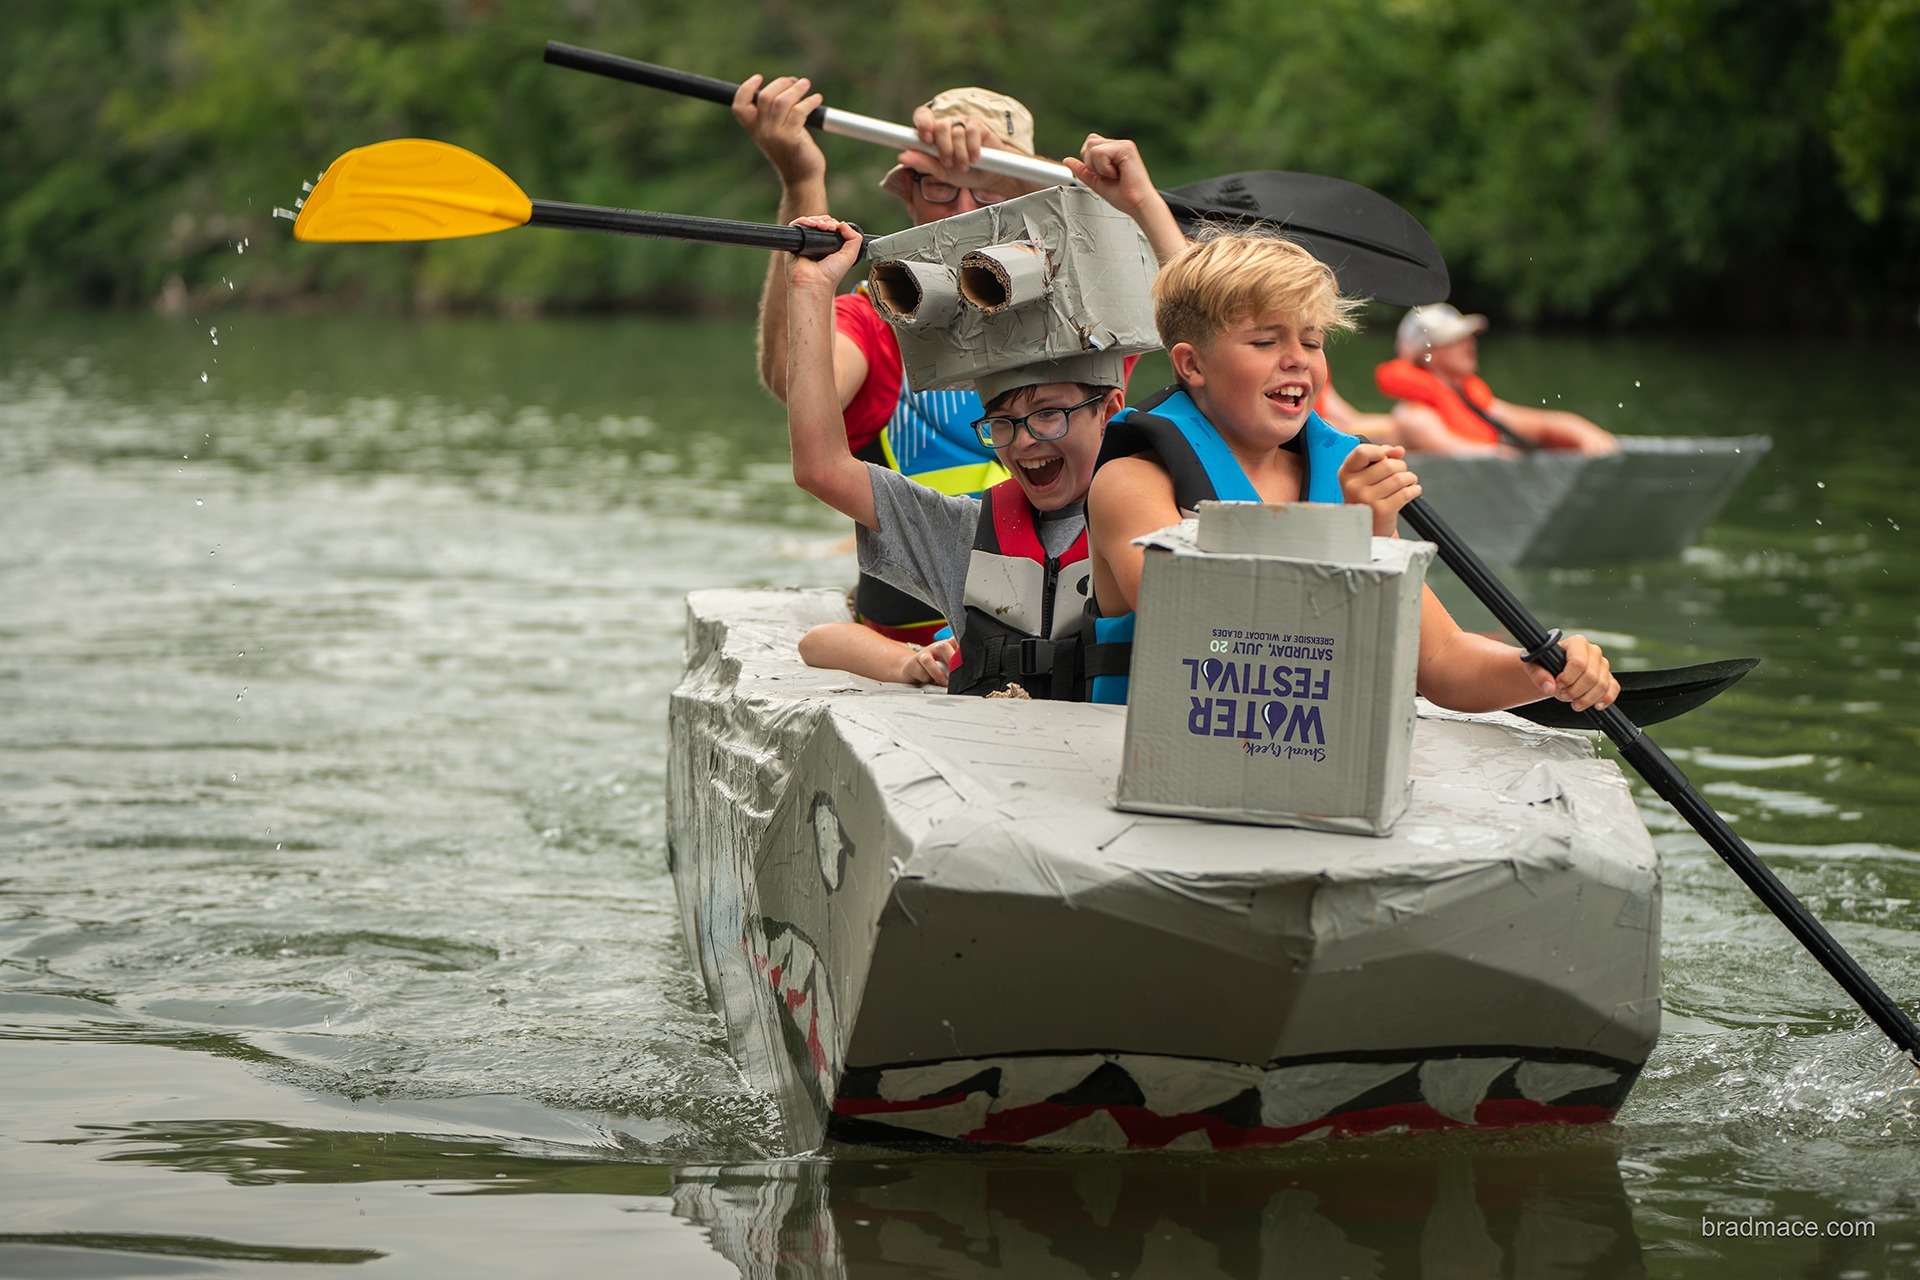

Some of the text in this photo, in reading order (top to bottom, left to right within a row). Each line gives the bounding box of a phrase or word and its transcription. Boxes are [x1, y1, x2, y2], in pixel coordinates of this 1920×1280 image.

[1212, 629, 1335, 645] CREEKSIDE AT WILDCAT GLADES
[1209, 640, 1333, 661] SATURDAY, JULY 20
[1182, 657, 1331, 700] FESTIVAL
[1188, 696, 1326, 745] WATER
[1242, 741, 1326, 762] Shoal Creek
